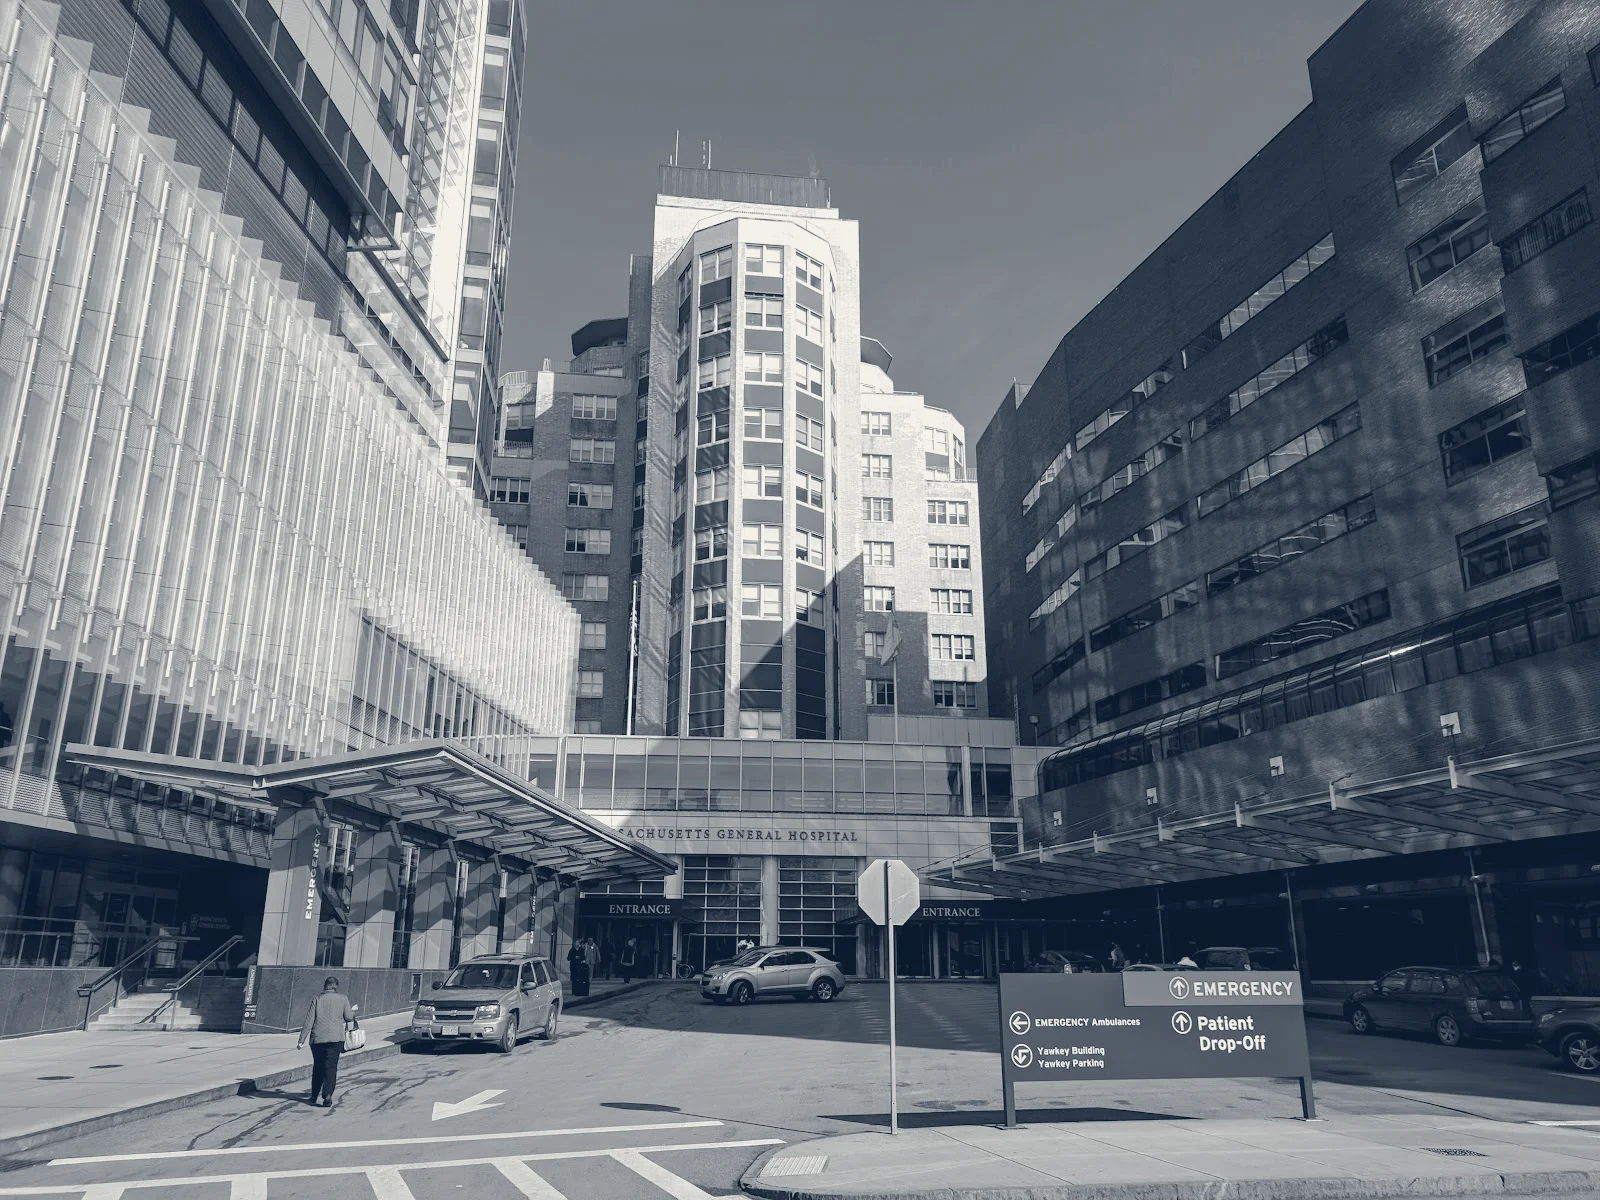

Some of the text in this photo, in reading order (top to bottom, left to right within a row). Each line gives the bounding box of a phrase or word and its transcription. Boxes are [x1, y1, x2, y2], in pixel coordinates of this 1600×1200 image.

[717, 829, 781, 841] GENERAL
[788, 831, 857, 842] HOSPITAL
[304, 828, 321, 920] EMERGENCY
[608, 904, 671, 916] ENTRANCE
[922, 907, 981, 919] ENTRANCE
[1193, 981, 1293, 996] EMERGENCY
[1035, 1018, 1141, 1027] EMERGENCY Ambulances
[1197, 1015, 1254, 1031] Patient
[1199, 1035, 1266, 1053] Drop-Off
[1037, 1046, 1105, 1057] Yawkey Building
[1038, 1059, 1105, 1069] Yawkey Parking
